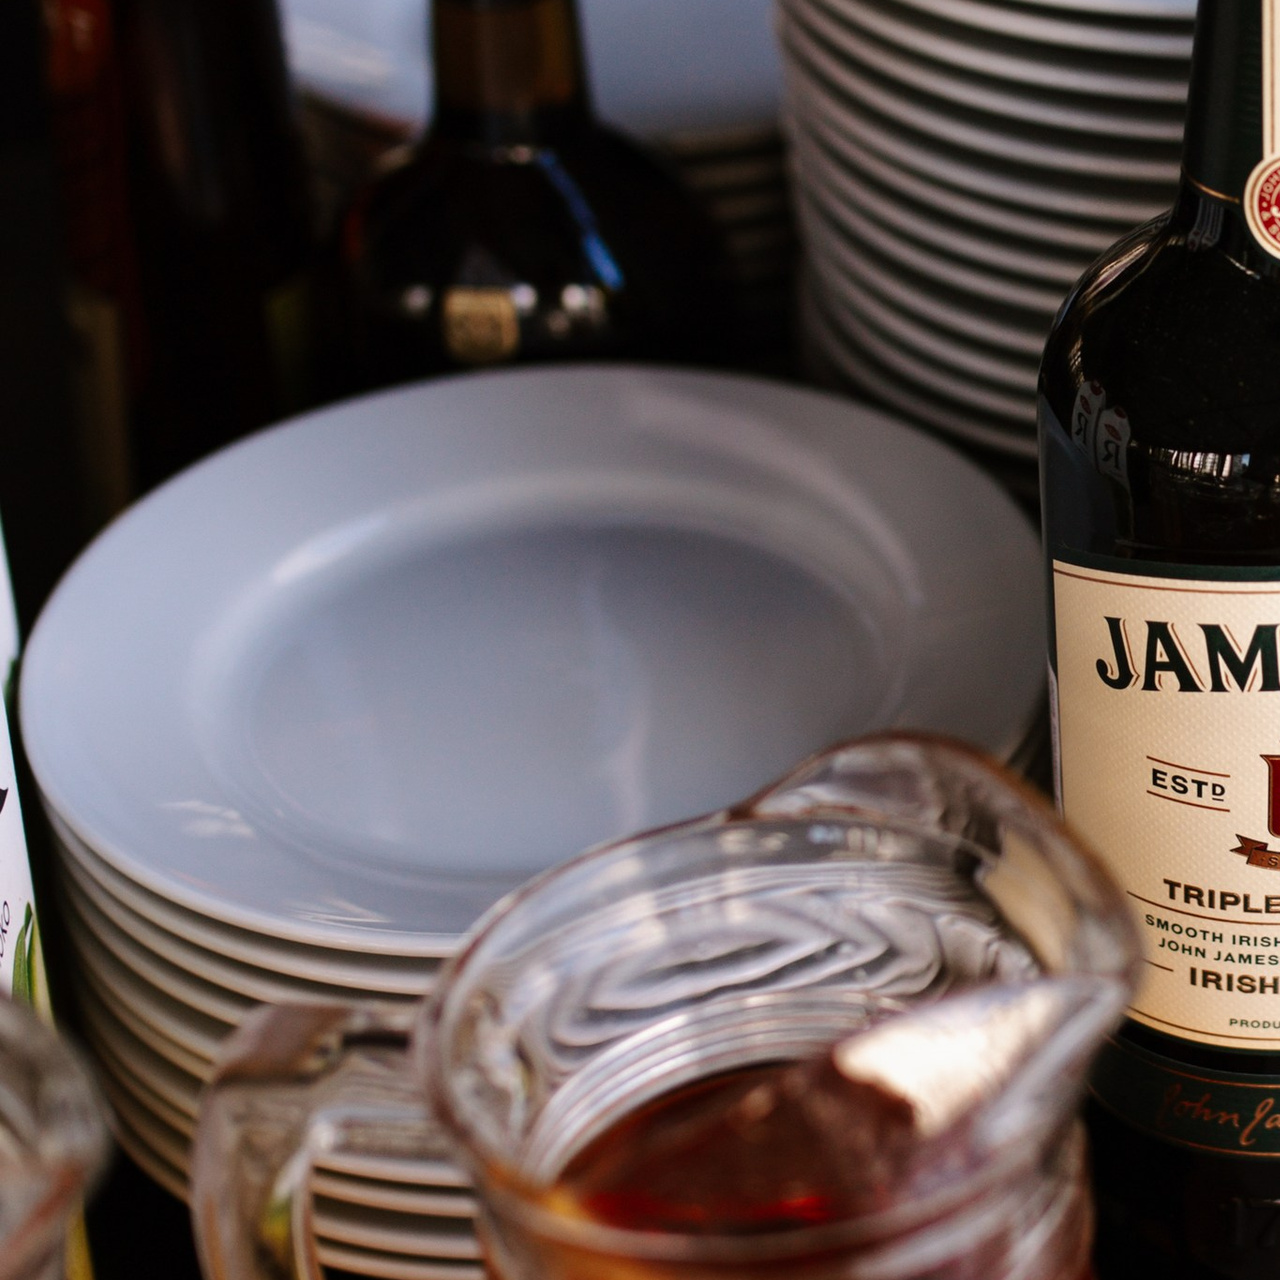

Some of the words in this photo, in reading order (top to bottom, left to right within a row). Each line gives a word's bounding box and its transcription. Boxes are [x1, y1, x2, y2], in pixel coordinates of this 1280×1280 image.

[1261, 211, 1272, 222] &
[1145, 913, 1225, 944] SMOOTH
[1157, 937, 1207, 960] JOHN
[1189, 966, 1280, 995] IRISH
[1155, 1082, 1241, 1130] John
